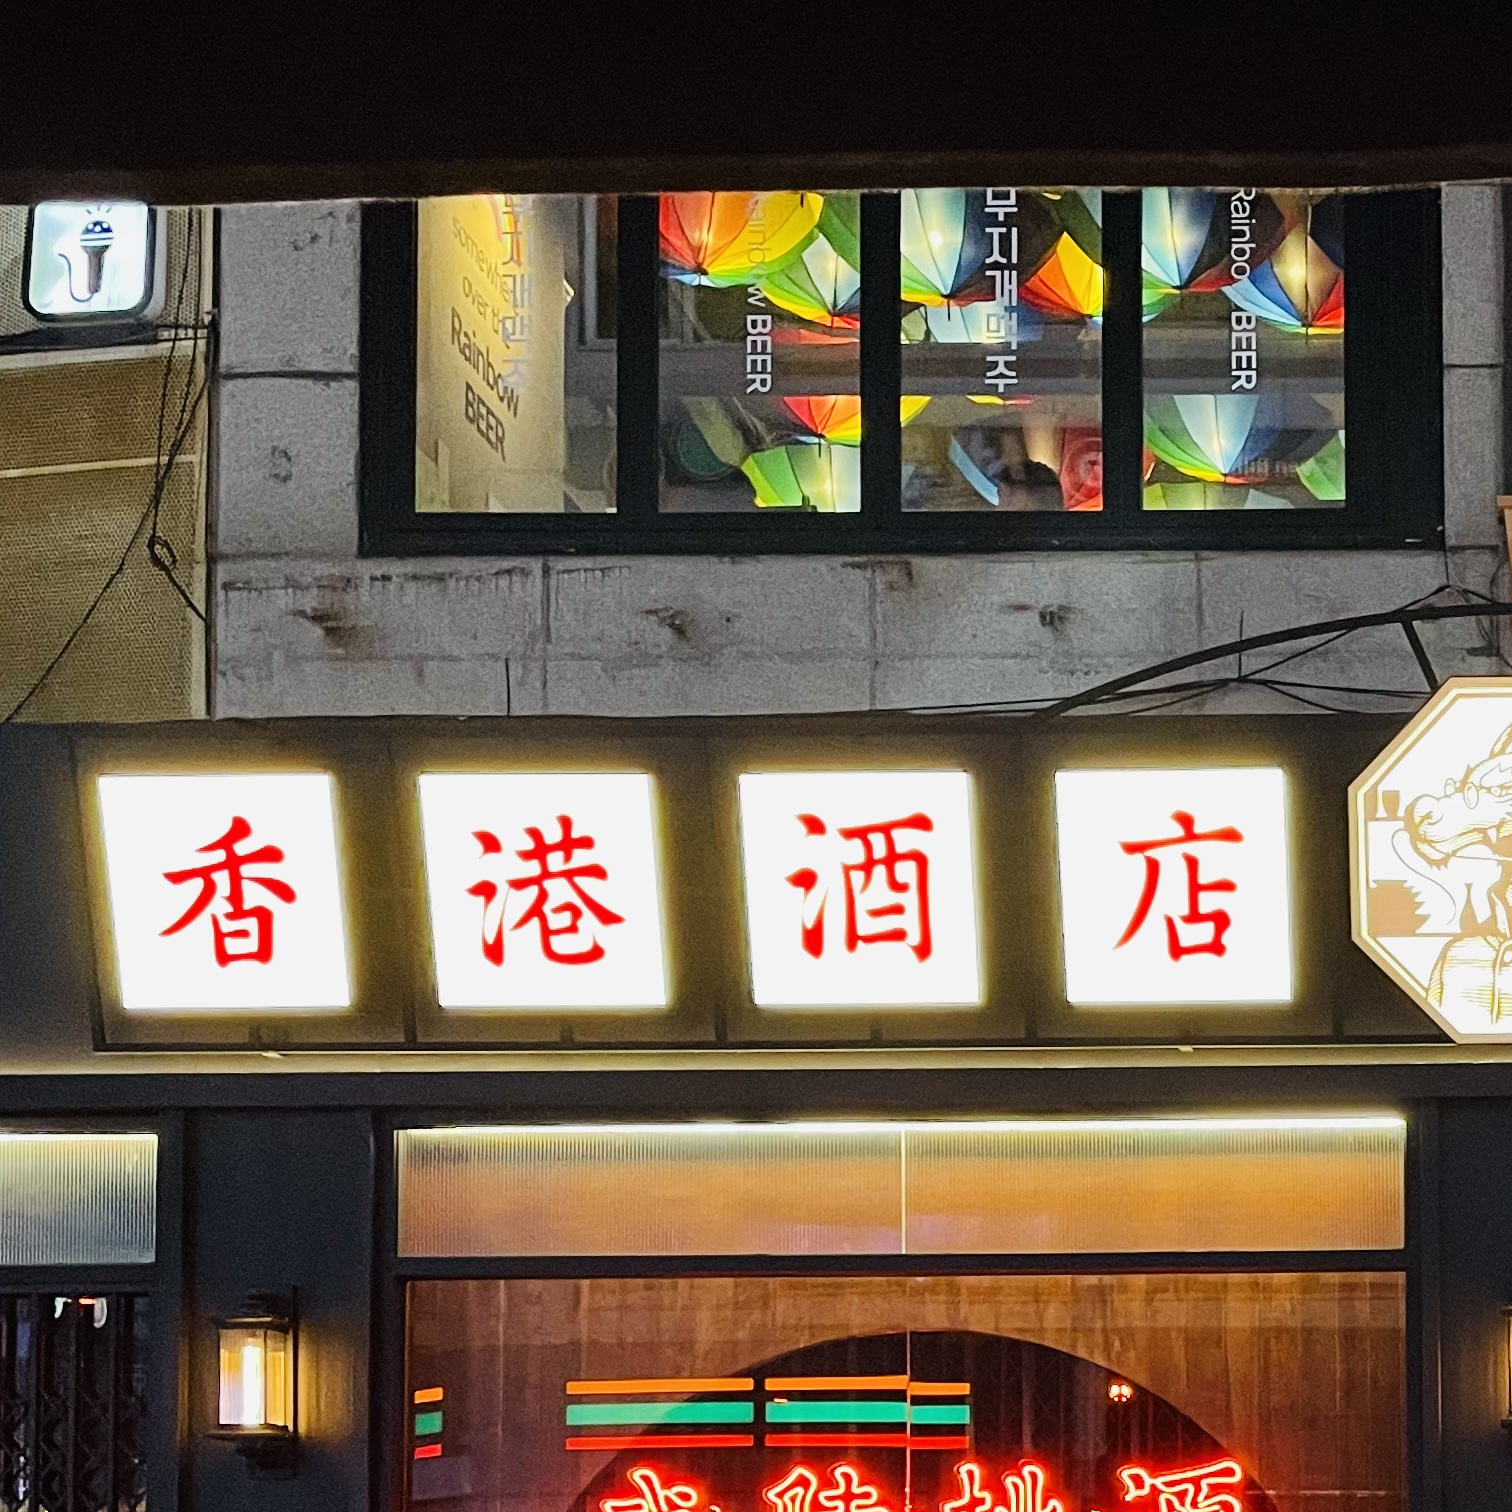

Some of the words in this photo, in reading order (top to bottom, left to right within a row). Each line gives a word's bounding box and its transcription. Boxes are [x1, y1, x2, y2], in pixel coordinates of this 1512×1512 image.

[452, 216, 519, 317] somewhe
[984, 187, 1018, 393] 무지개맥주
[1230, 187, 1256, 304] Rainbo
[450, 306, 520, 419] Rainbow
[746, 314, 772, 394] BEER
[1230, 311, 1257, 391] BEER
[464, 380, 506, 462] BEER
[159, 811, 1244, 969] 香港酒店
